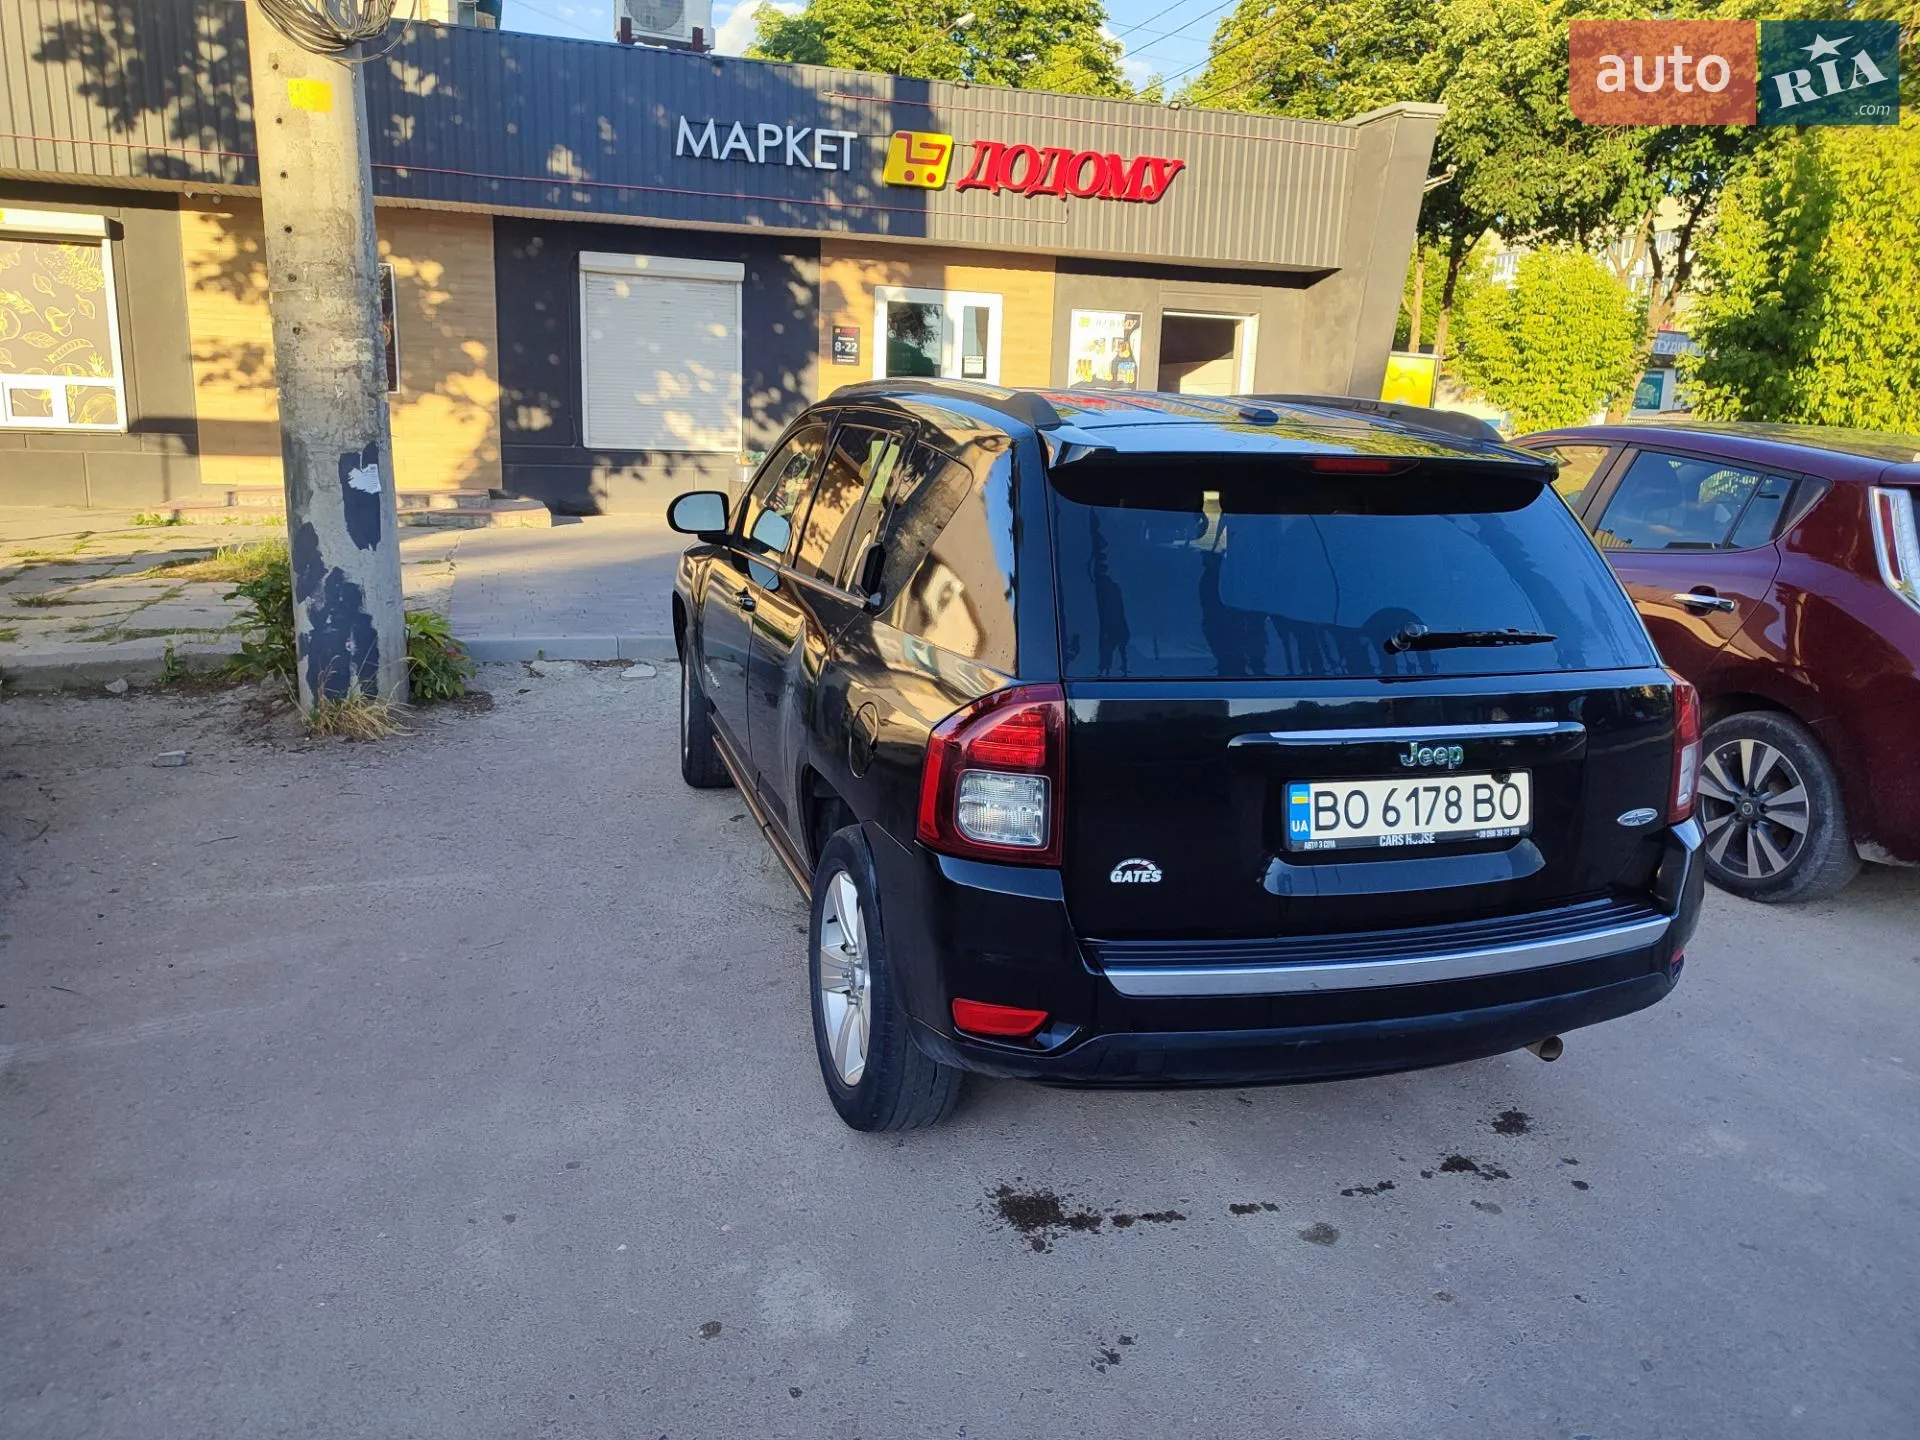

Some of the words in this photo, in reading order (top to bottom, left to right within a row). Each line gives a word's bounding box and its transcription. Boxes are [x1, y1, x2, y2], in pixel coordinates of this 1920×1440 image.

[675, 115, 858, 171] МАРКЕТ
[956, 140, 1184, 204] ДОДОМУ
[1401, 742, 1464, 769] Jeep
[1314, 789, 1369, 831] BO
[1382, 785, 1463, 828] 6178
[1291, 820, 1309, 832] UA
[1379, 834, 1404, 847] CARS
[1405, 832, 1436, 845] HUSE
[1110, 870, 1162, 883] GATES
